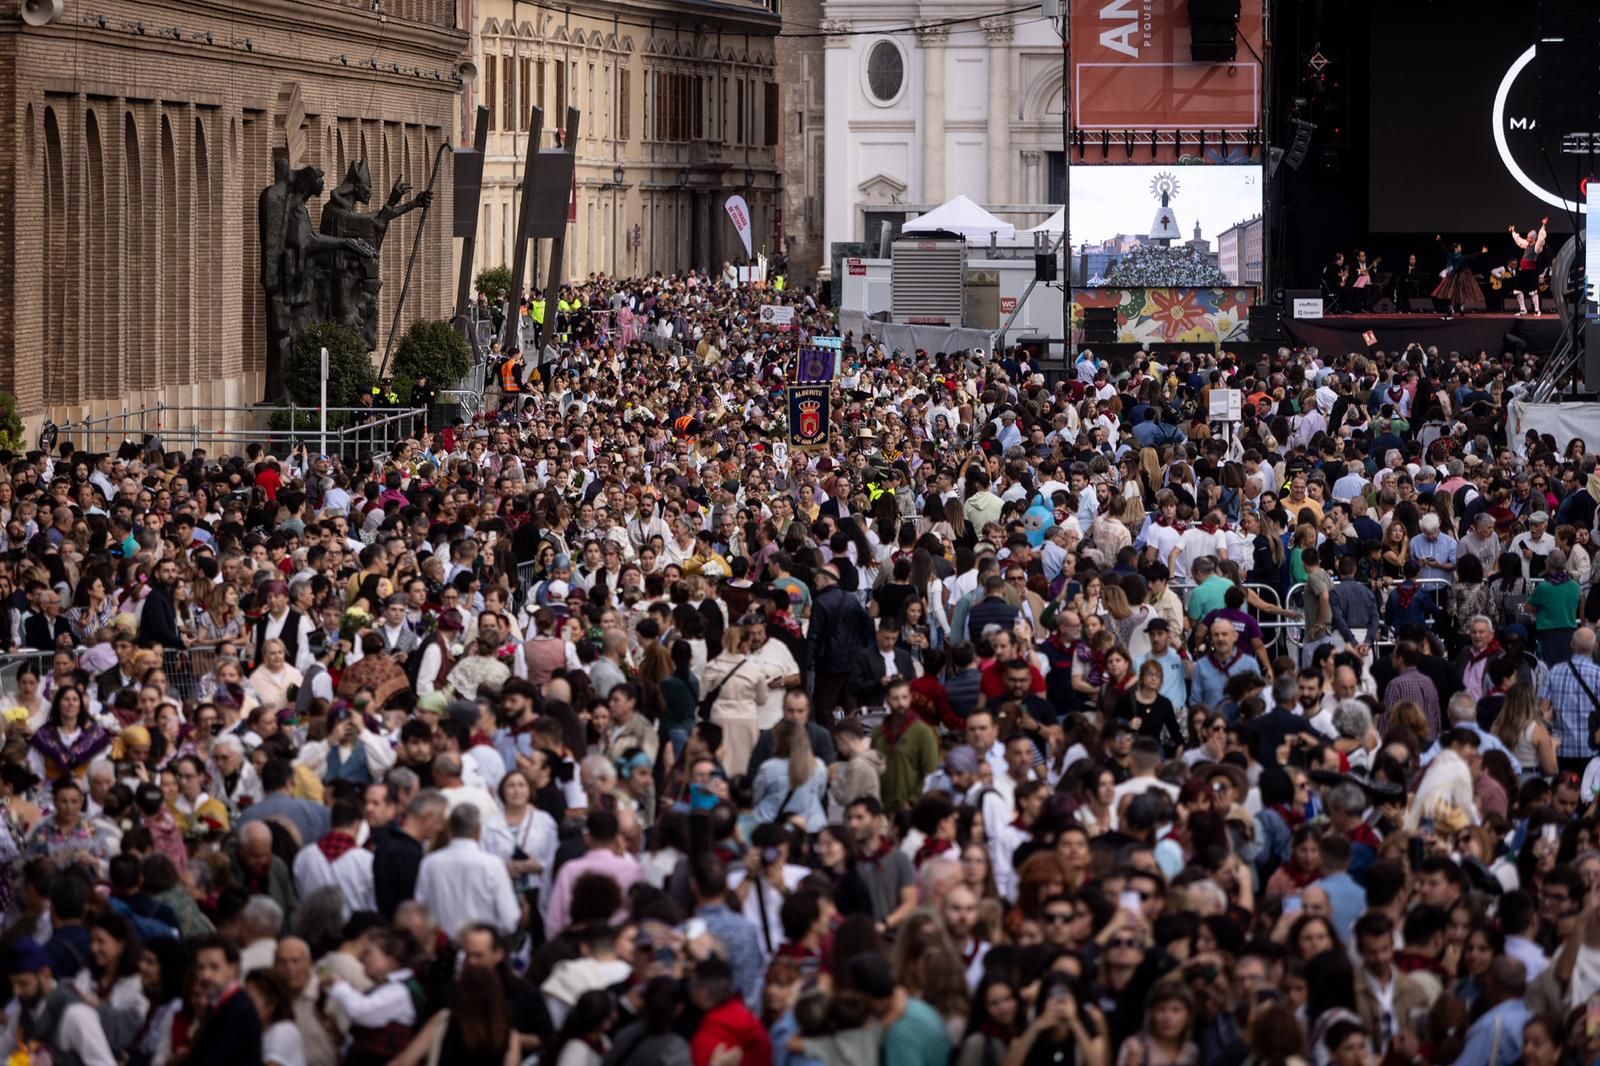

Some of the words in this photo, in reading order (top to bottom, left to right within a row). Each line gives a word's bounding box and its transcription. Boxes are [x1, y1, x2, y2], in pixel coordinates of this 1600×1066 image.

[1143, 0, 1152, 47] PEQUE
[1001, 300, 1015, 308] WC
[795, 389, 824, 399] ALBERITE
